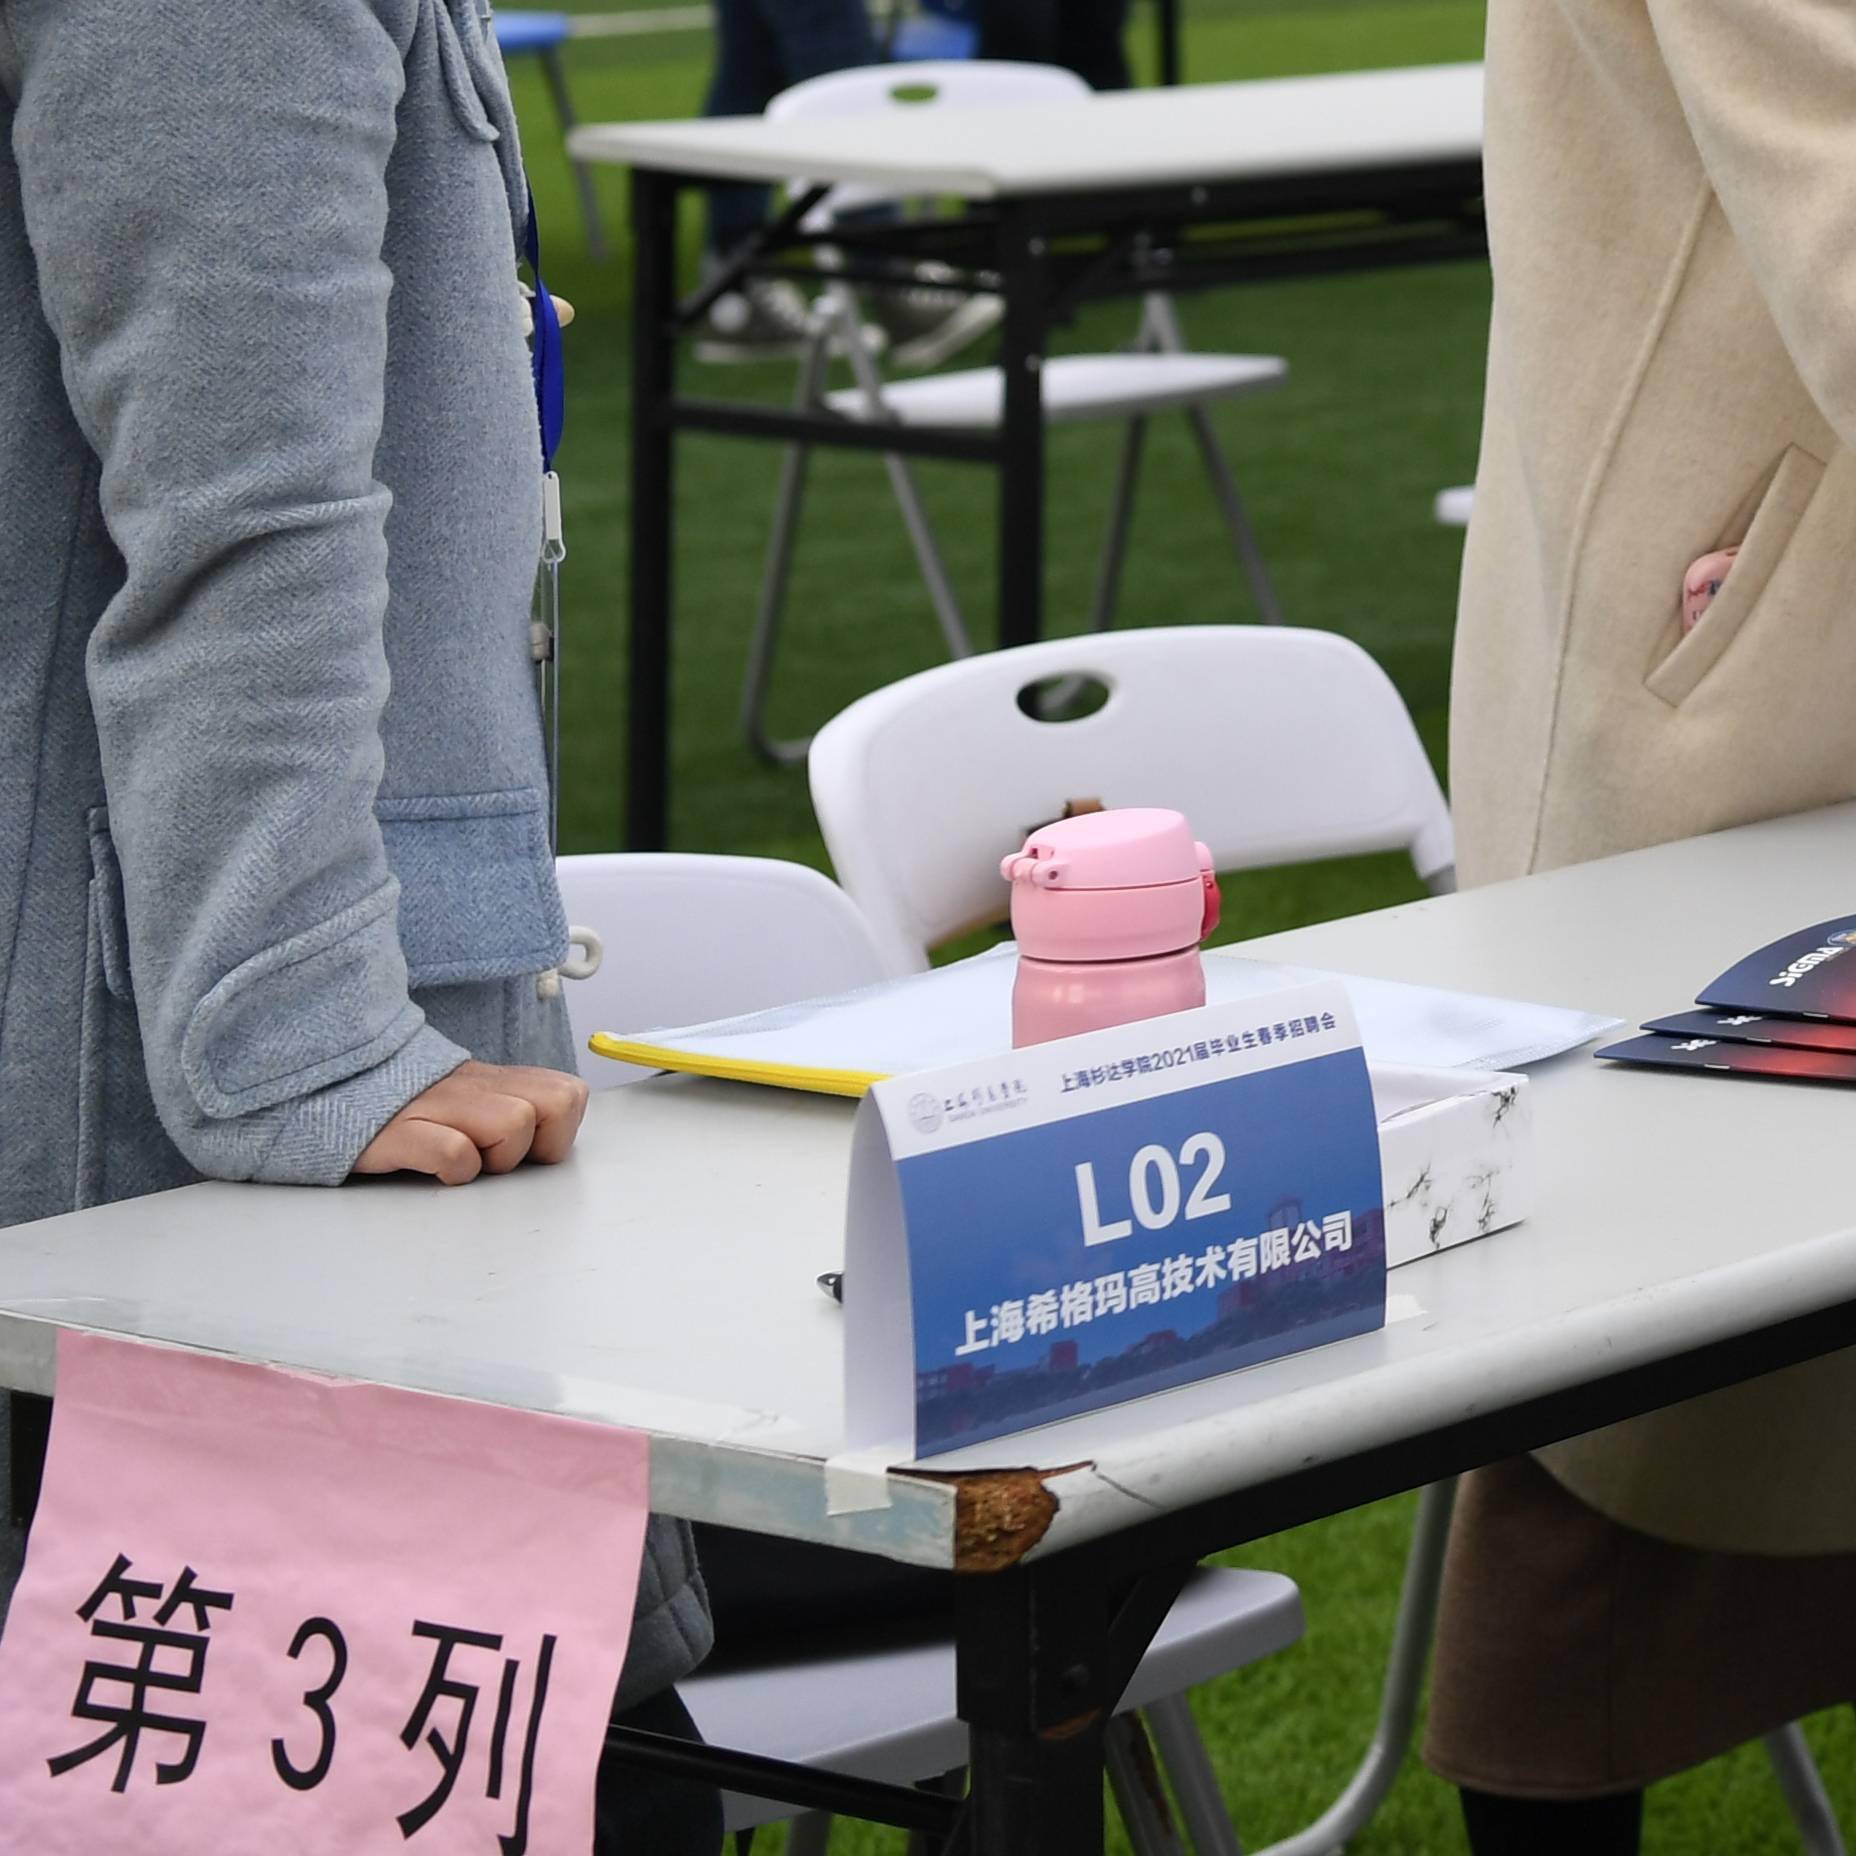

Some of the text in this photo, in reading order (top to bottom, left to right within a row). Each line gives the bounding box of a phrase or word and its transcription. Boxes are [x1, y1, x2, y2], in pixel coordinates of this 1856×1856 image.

[1061, 1012, 1337, 1093] 上海杉达学院2021届毕业生春季招聘会
[1075, 1131, 1231, 1249] L02
[955, 1210, 1352, 1356] 上海希格玛高技术有限公司
